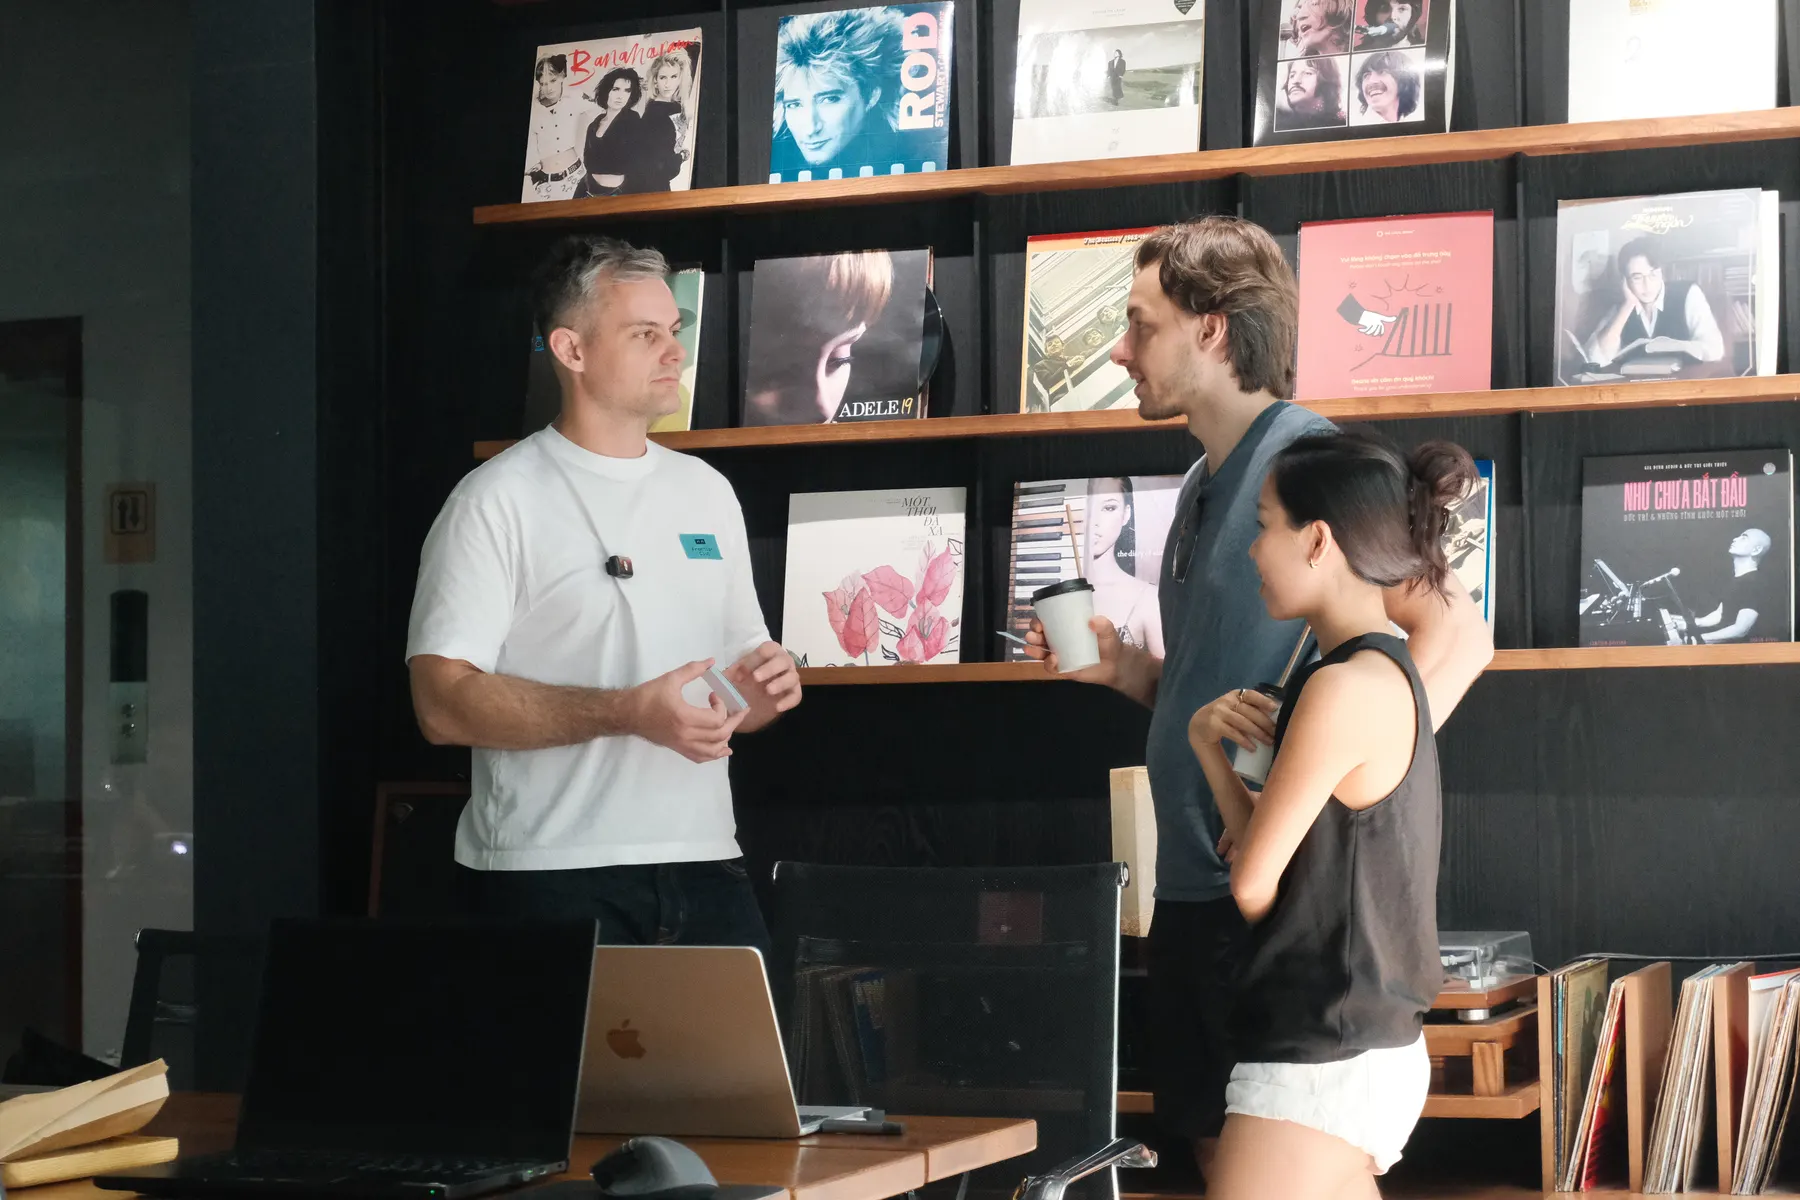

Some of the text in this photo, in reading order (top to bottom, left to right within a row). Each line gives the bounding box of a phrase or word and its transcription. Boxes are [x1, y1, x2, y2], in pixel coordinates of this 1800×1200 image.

[899, 12, 938, 130] ROD
[934, 70, 947, 128] STEWART
[839, 397, 914, 418] ADELE 19
[1624, 470, 1747, 511] NHƯ CHƯA BẮT ĐẦU
